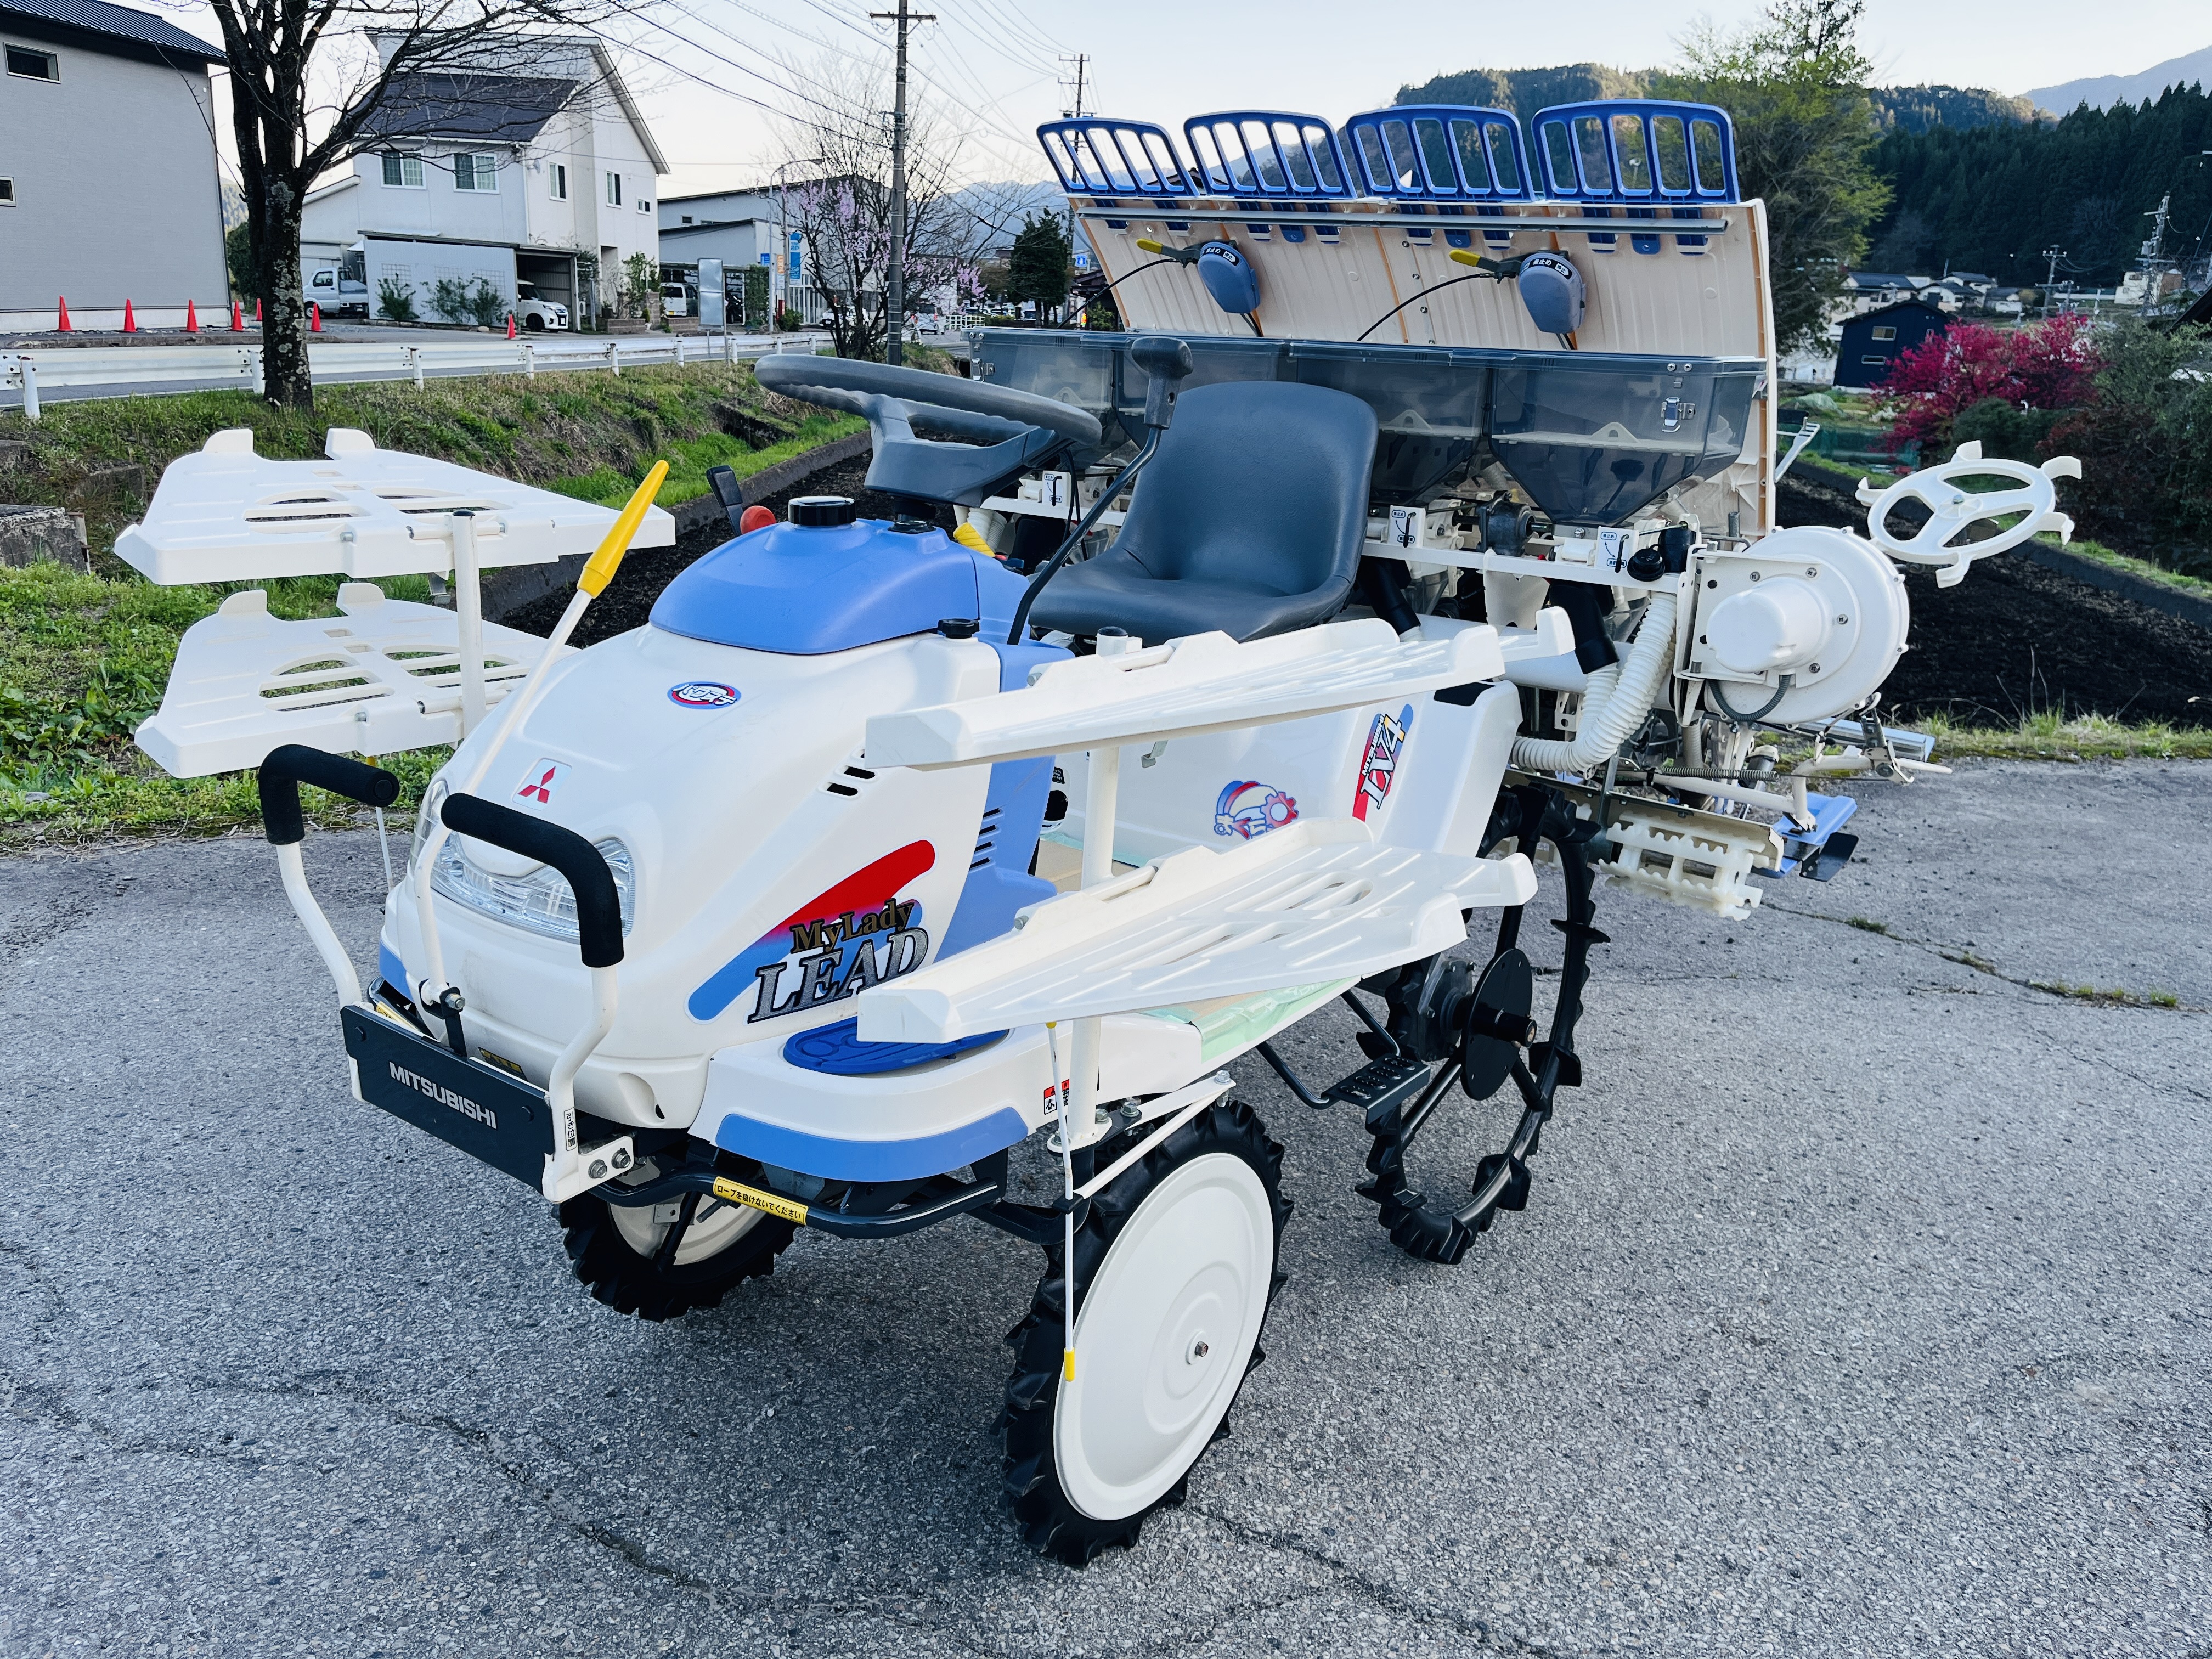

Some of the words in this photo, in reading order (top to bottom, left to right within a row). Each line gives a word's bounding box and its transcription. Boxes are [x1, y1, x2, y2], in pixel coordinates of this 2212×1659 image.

[672, 684, 738, 706] パワステ
[1360, 713, 1406, 810] LV4
[1362, 714, 1385, 777] MITSUBISHI
[789, 898, 915, 954] MyLady
[747, 927, 929, 1024] LEAD
[389, 1062, 497, 1130] MITSUBISHI
[717, 1185, 801, 1219] ロープを掛けないでください
